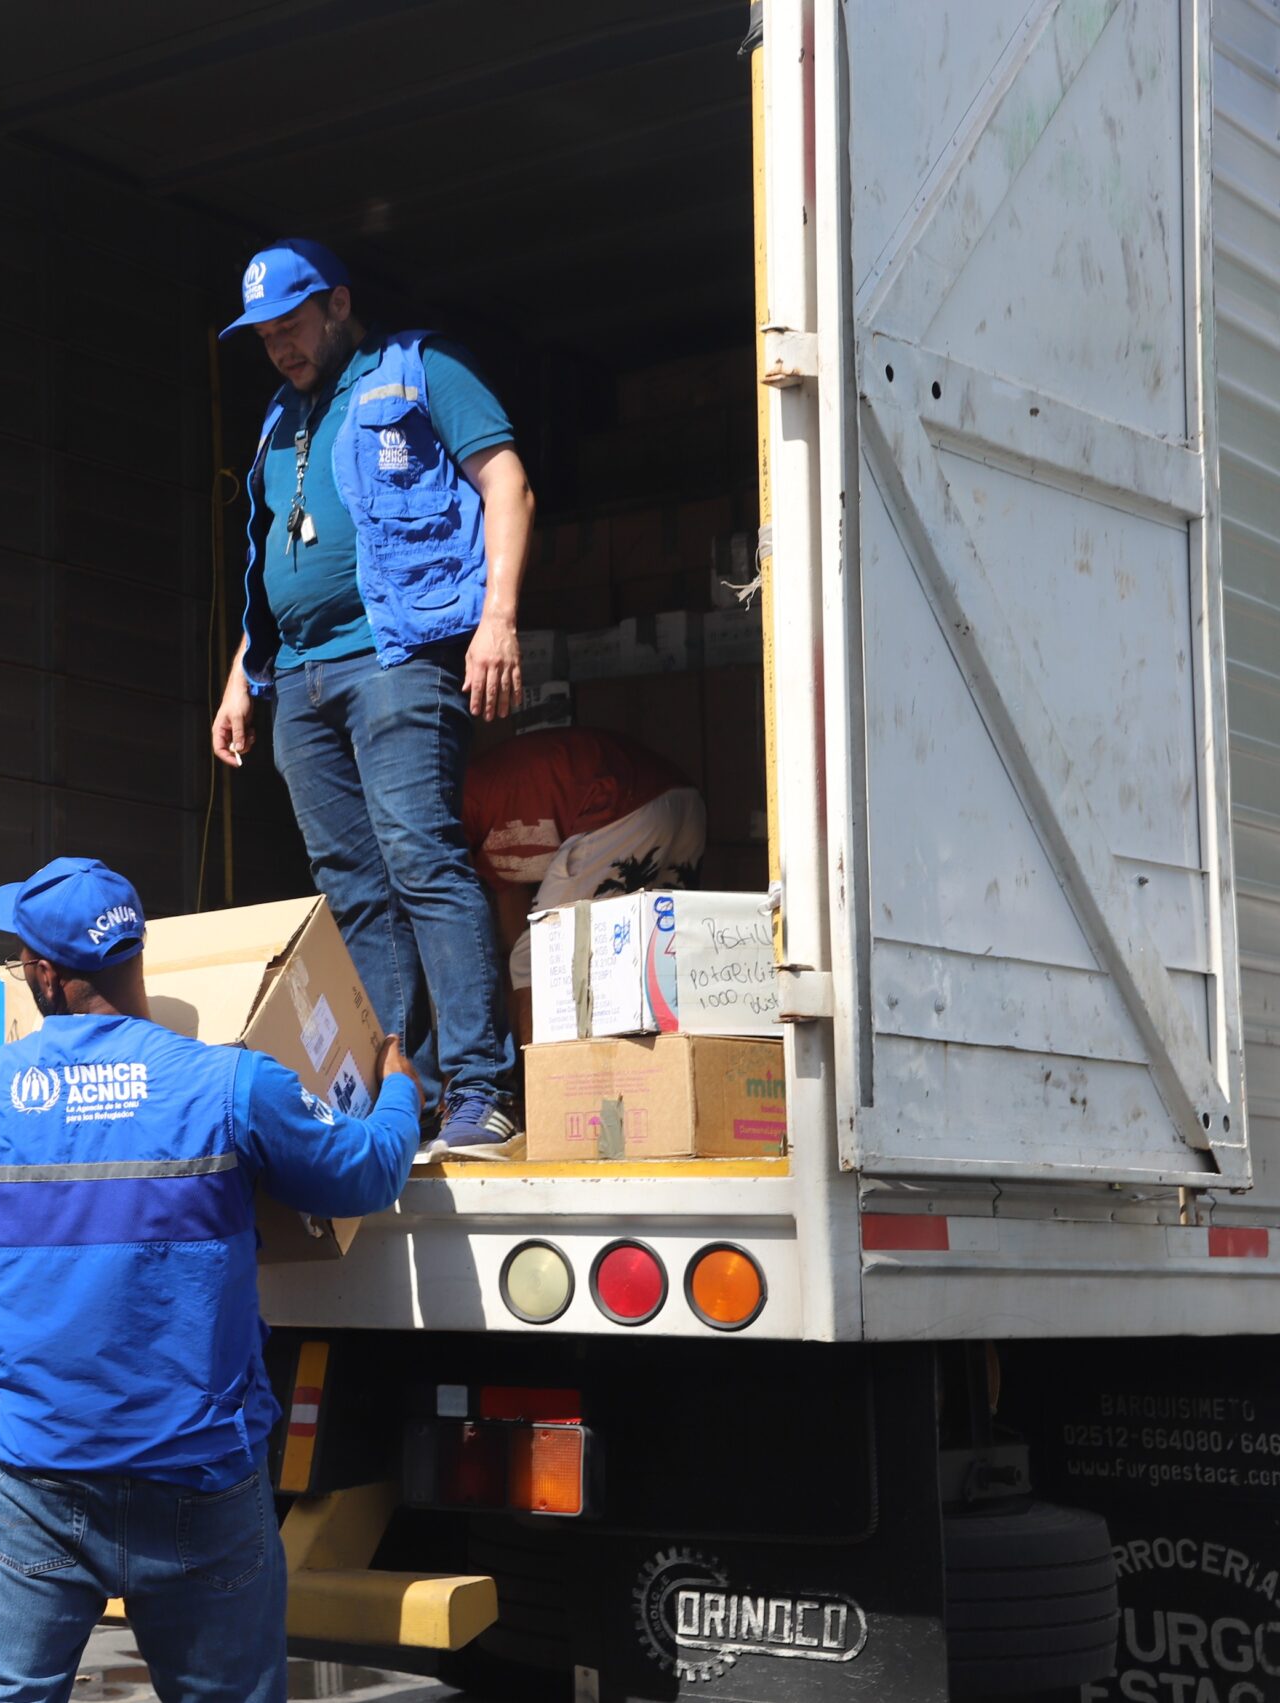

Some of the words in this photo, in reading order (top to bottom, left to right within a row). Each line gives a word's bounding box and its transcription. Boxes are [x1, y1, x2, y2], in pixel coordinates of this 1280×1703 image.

[88, 905, 139, 945] ACNUR
[63, 1063, 147, 1084] UNHCR
[67, 1081, 148, 1105] ACNUR
[105, 1102, 114, 1110] de
[123, 1101, 140, 1109] ONU
[1100, 1393, 1257, 1422] BARQUISIMETO
[677, 1591, 849, 1649] ORINOCO
[1119, 1607, 1280, 1677] URGO
